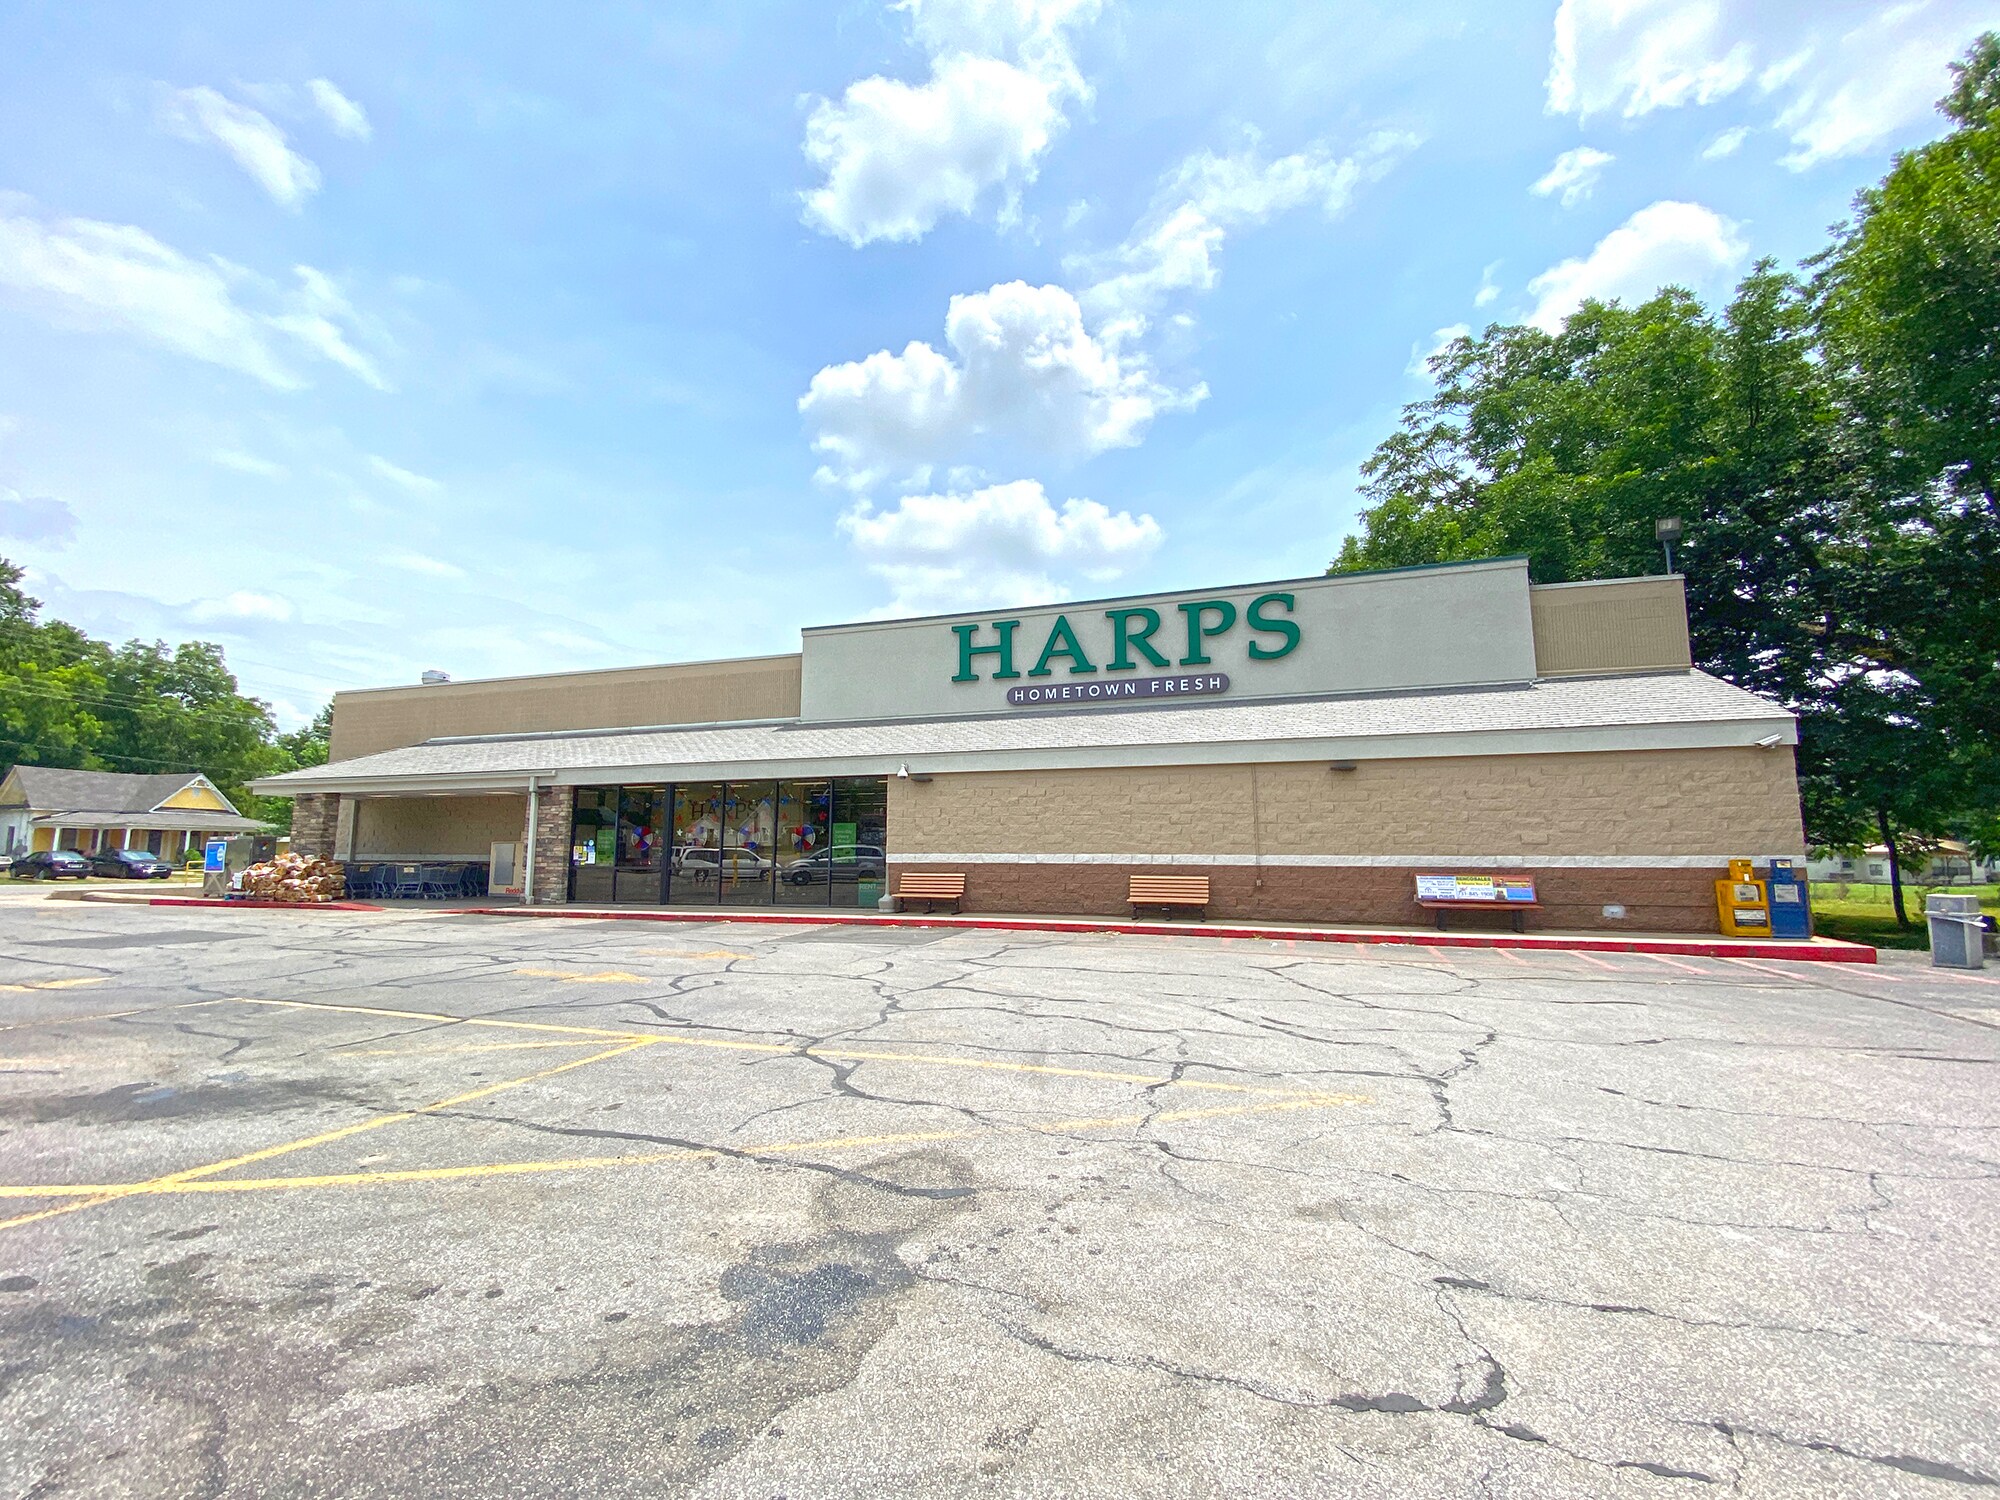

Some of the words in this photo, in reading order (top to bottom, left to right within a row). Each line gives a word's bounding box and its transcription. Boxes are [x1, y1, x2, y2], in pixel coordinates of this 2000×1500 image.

[951, 593, 1301, 682] HARPS
[1014, 682, 1136, 702] HOMETOWN
[1151, 677, 1222, 694] FRESH
